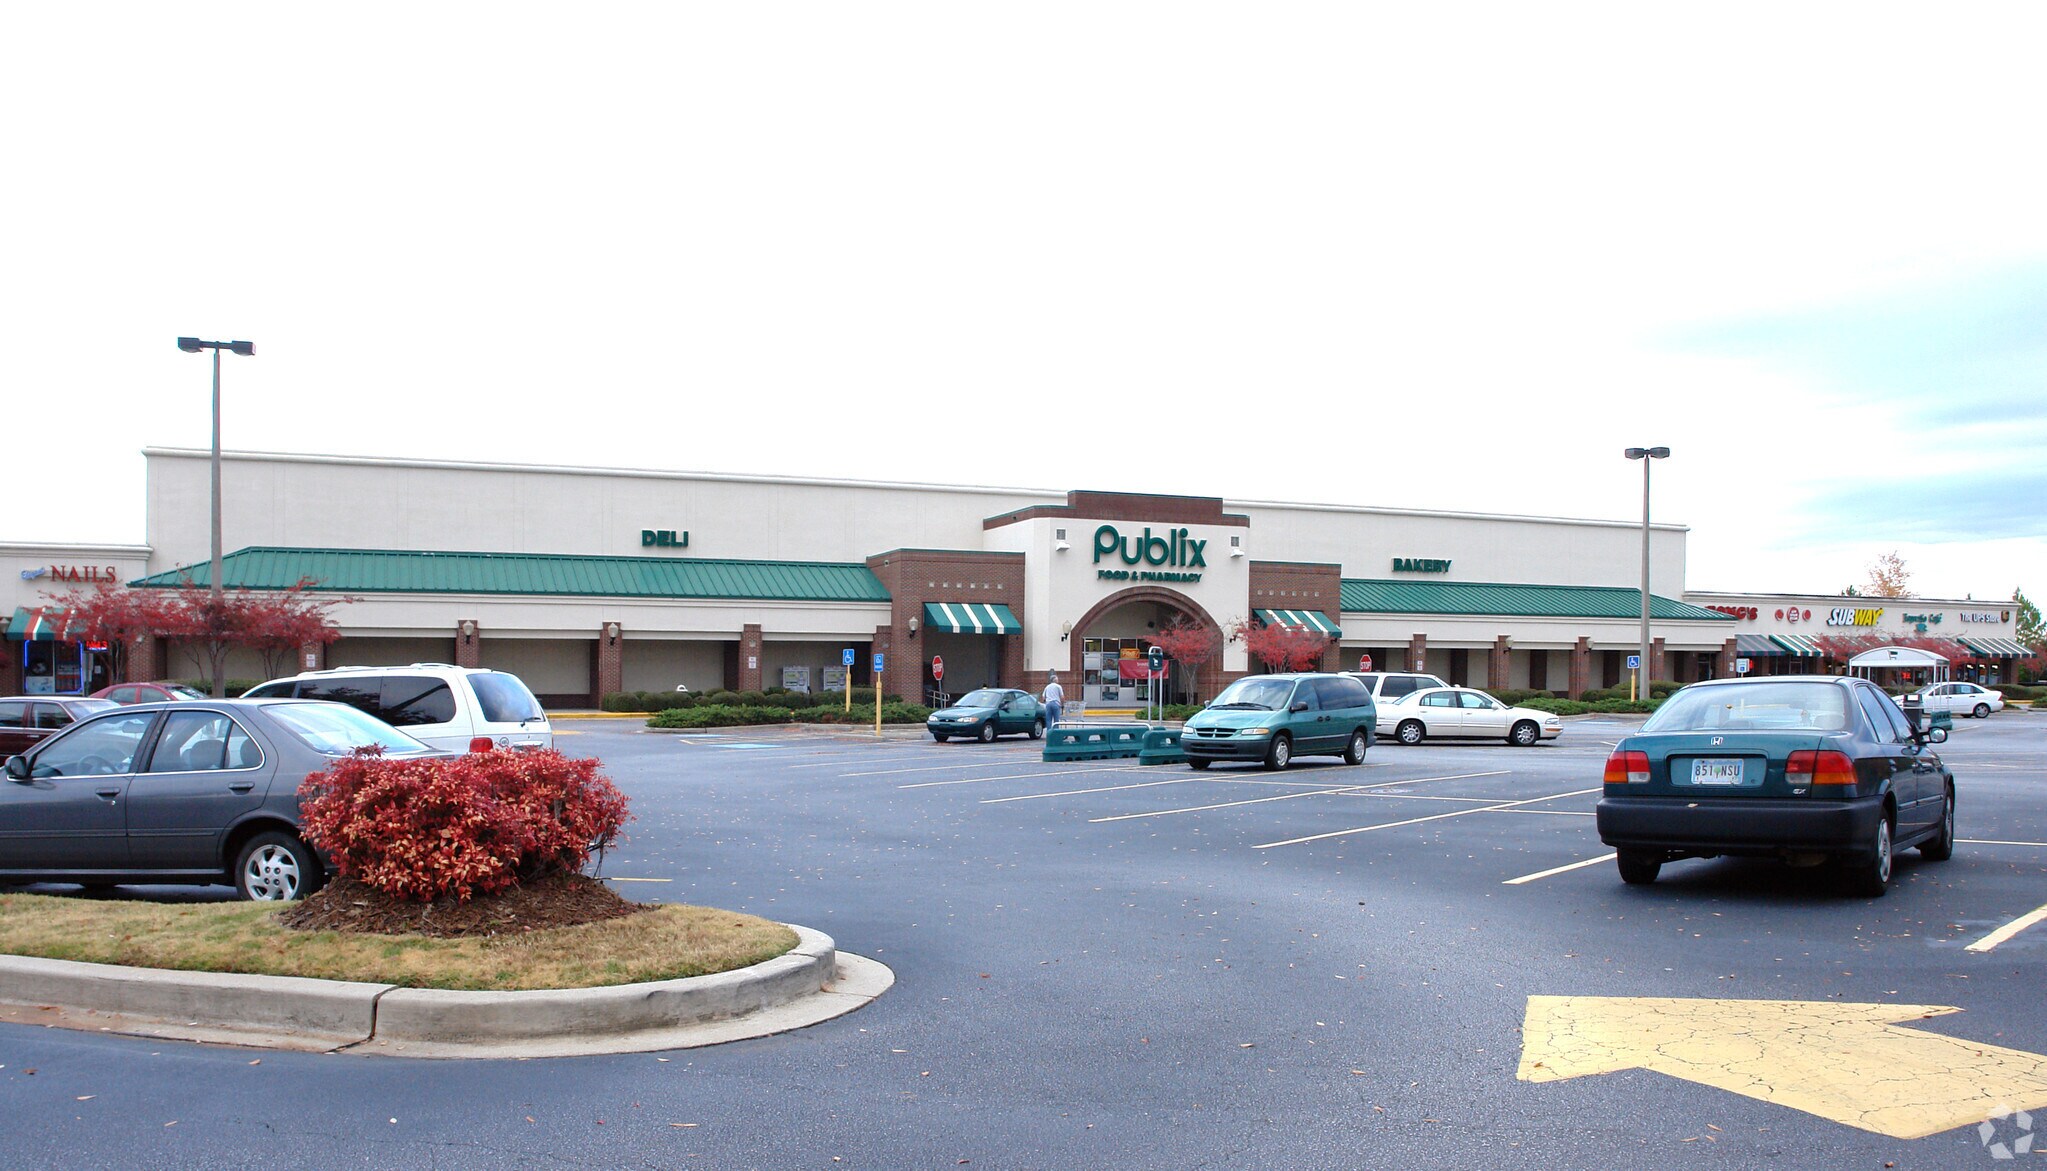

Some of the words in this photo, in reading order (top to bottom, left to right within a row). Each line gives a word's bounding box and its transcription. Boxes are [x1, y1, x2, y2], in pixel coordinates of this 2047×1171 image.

[641, 530, 689, 547] DELI
[1093, 525, 1207, 567] Publix
[1391, 558, 1452, 573] BAKERY
[50, 565, 116, 583] NAILS
[1098, 570, 1129, 580] FOOD
[1130, 572, 1138, 581] &
[1141, 572, 1202, 583] PHARMACY
[1826, 608, 1884, 626] SUBWAY
[1360, 661, 1371, 670] STOP
[1695, 765, 1713, 776] 851
[1721, 765, 1740, 776] NSU
